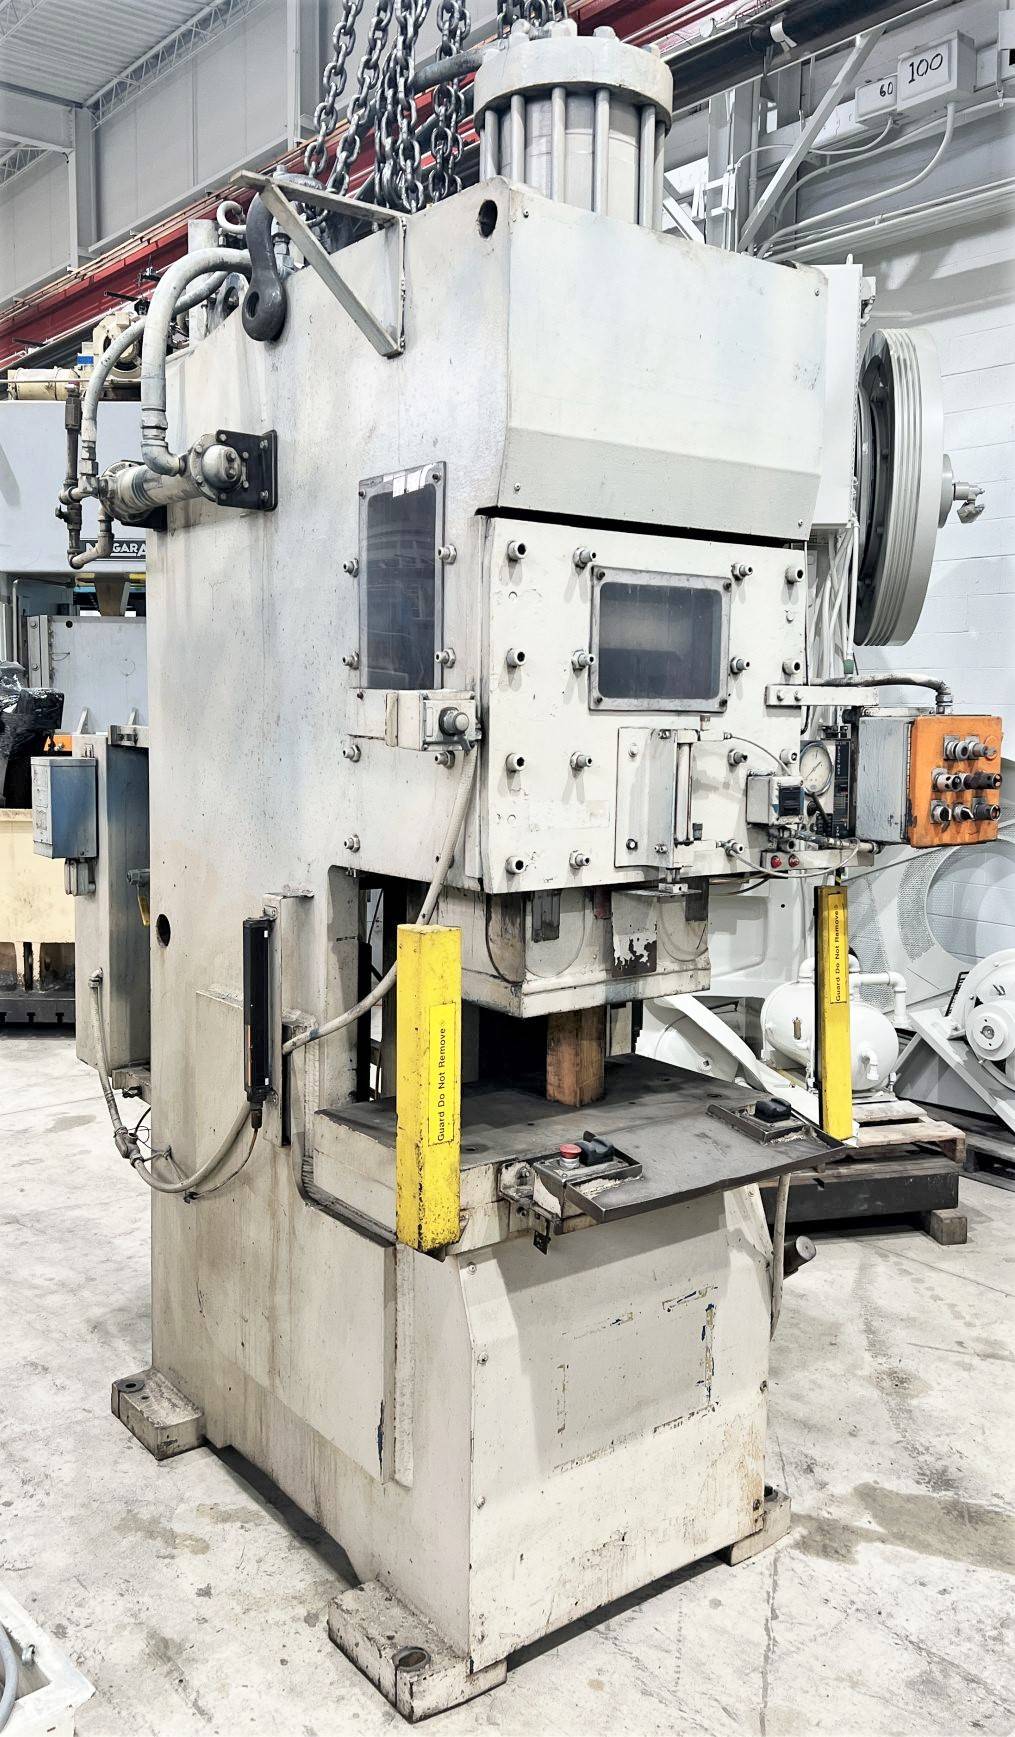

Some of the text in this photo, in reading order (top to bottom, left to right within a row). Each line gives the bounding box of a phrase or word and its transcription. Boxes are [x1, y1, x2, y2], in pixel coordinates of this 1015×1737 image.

[908, 53, 943, 84] 100
[880, 82, 893, 97] 60
[835, 962, 840, 974] Do
[438, 1028, 446, 1068] Remove
[438, 1071, 446, 1089] Not
[438, 1093, 445, 1107] Do
